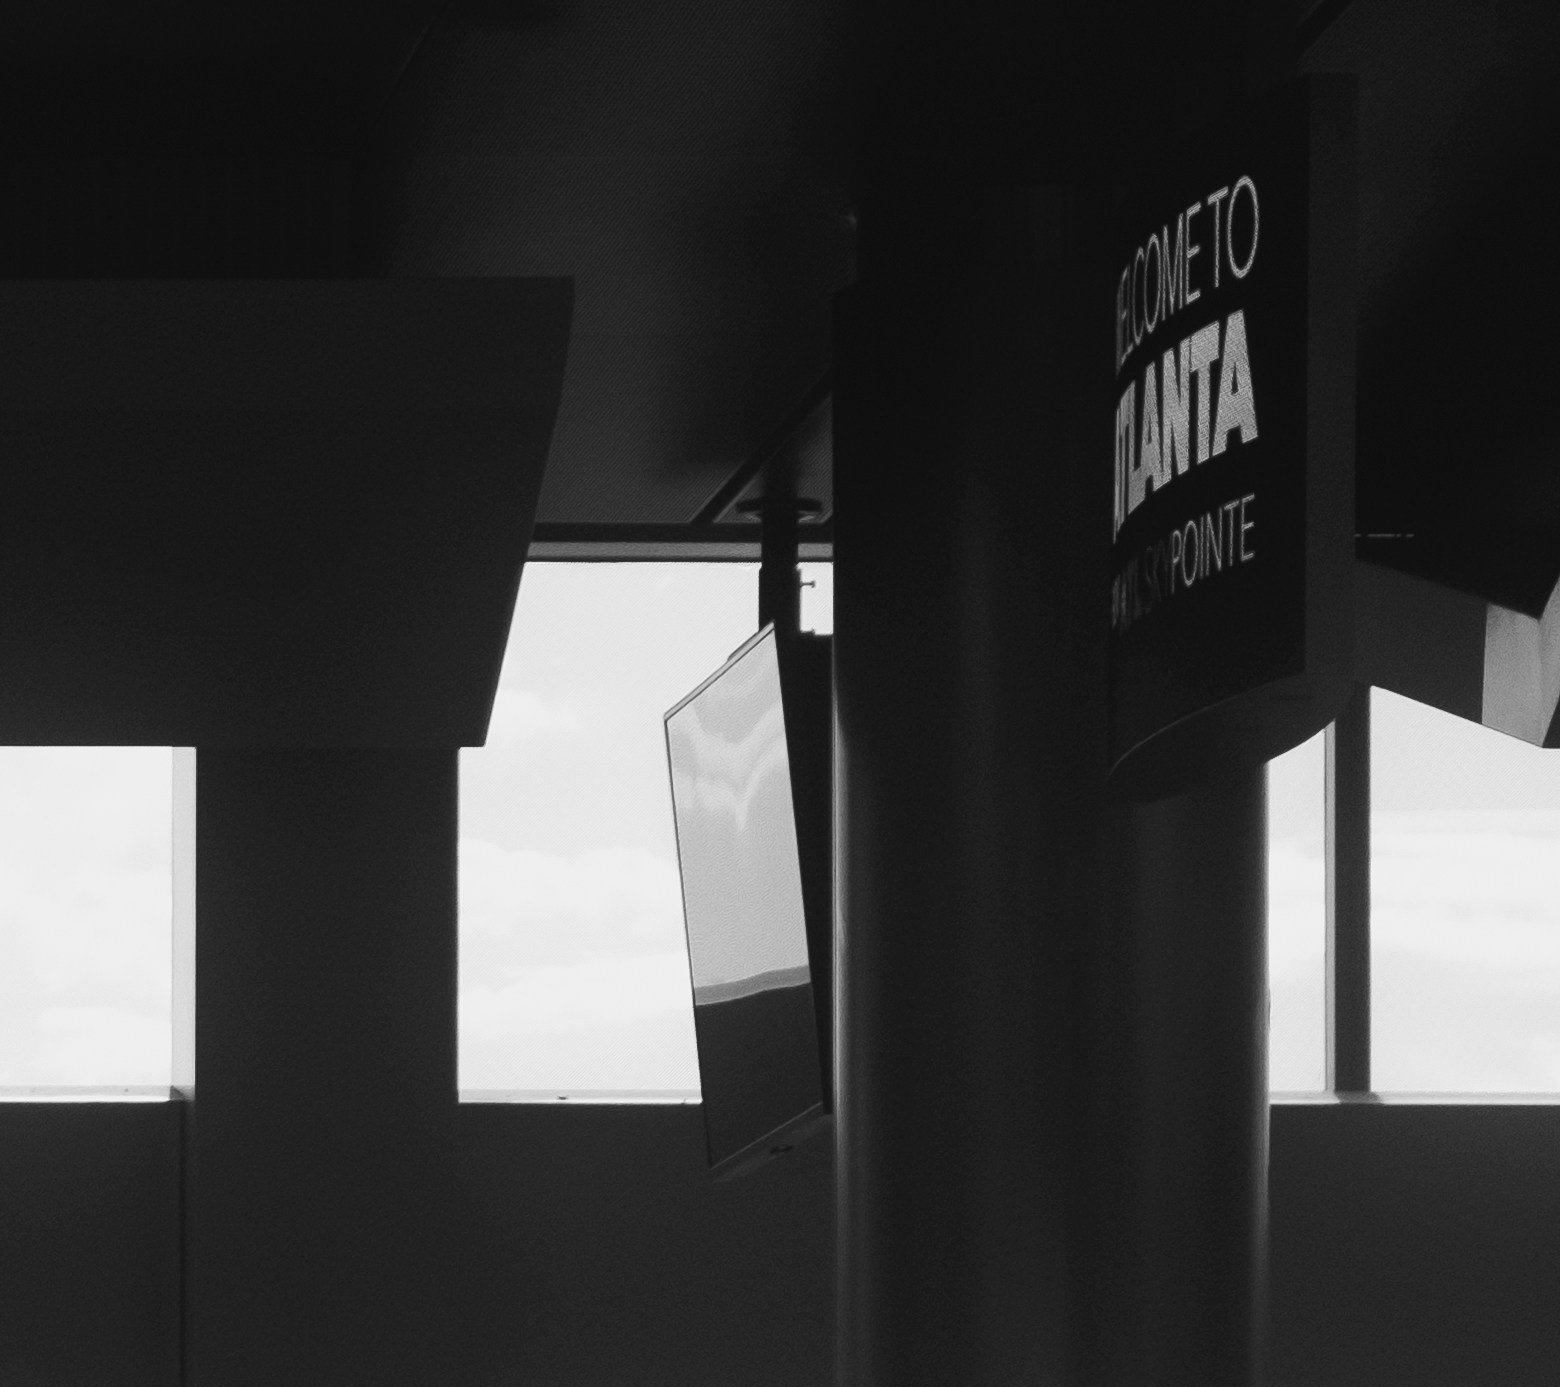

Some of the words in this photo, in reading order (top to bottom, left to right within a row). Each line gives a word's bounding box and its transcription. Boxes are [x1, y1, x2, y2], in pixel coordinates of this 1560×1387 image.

[1116, 201, 1202, 381] ELCOME
[1207, 174, 1260, 288] TO
[1112, 309, 1259, 544] TLANTA
